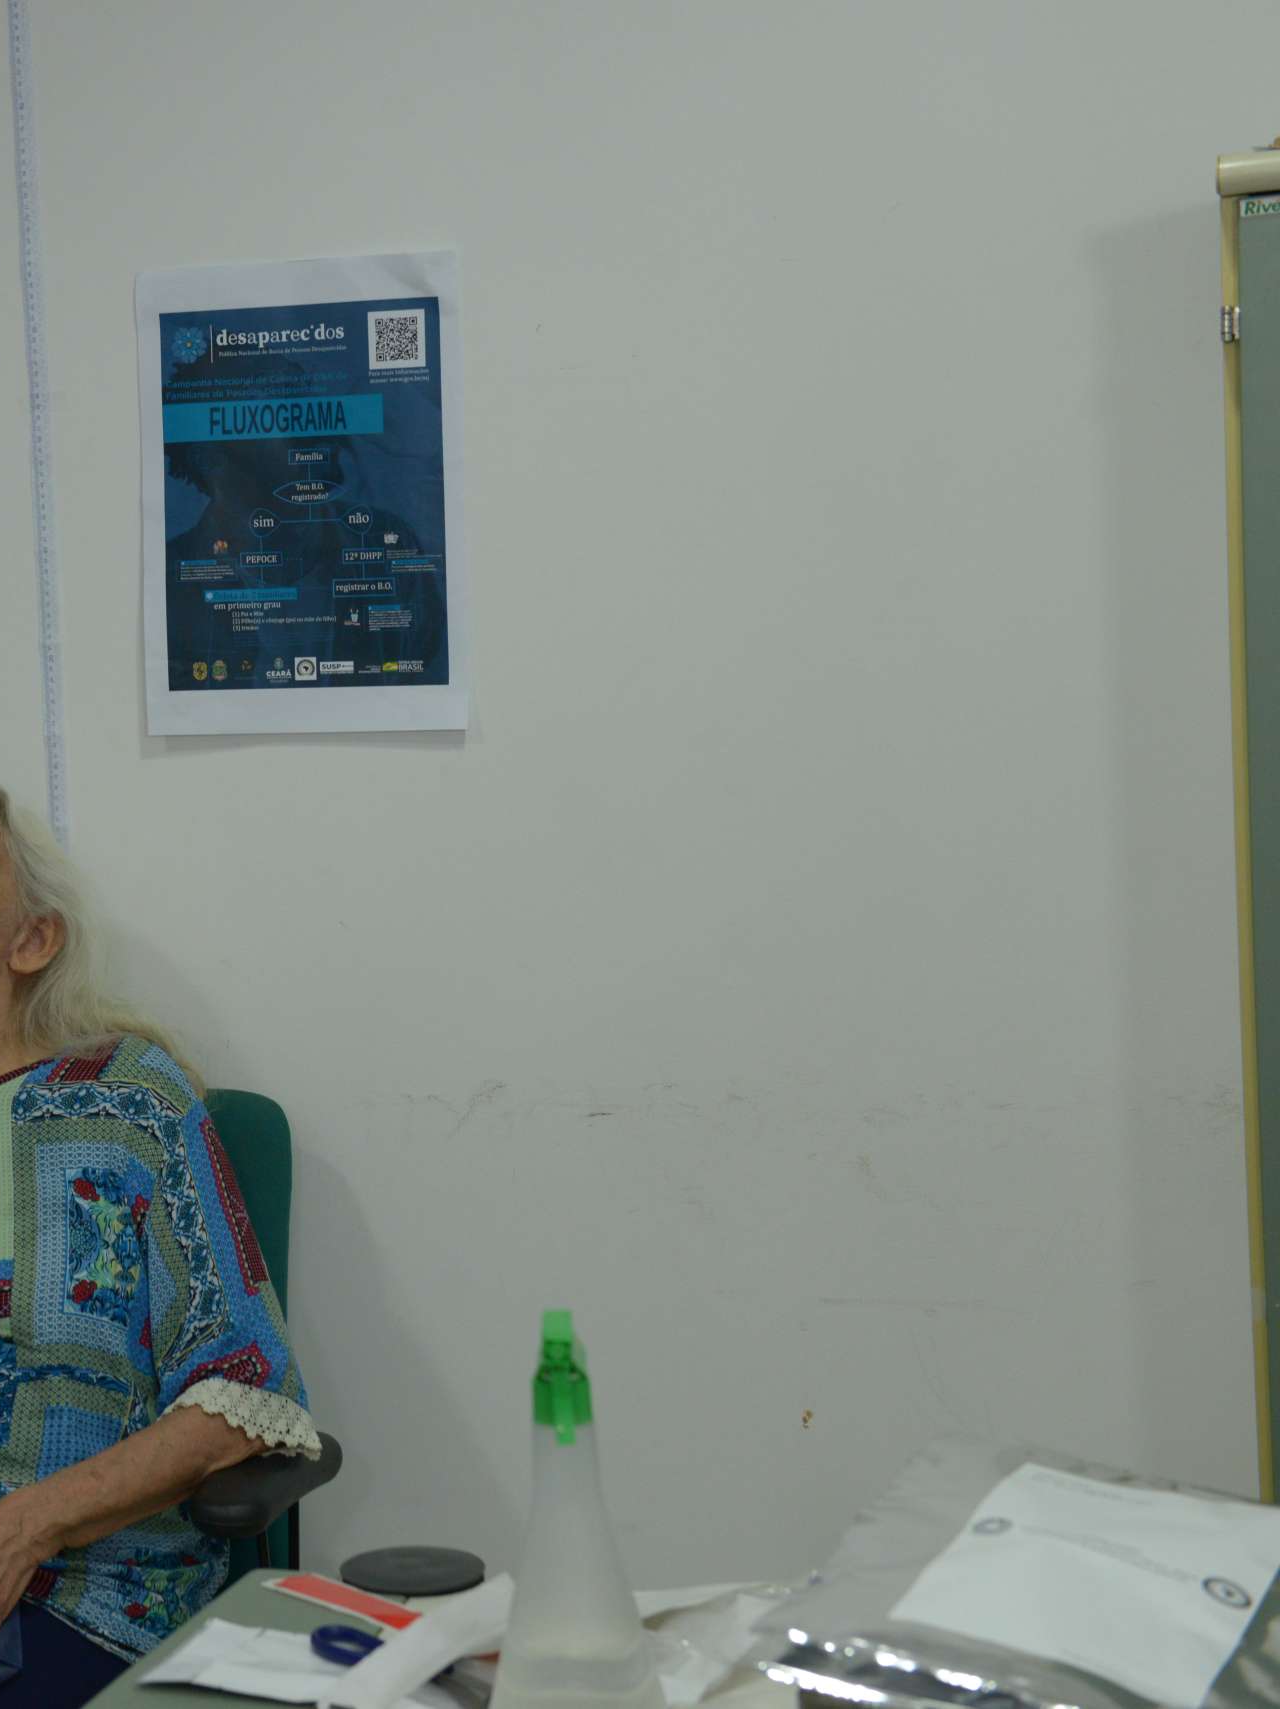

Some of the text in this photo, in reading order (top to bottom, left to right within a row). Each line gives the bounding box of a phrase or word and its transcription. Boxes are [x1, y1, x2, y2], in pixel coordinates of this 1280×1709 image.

[216, 324, 345, 349] desaparecdos
[209, 400, 347, 436] FLUXOGRAMA
[295, 452, 324, 462] Família
[296, 483, 310, 492] Tem
[291, 492, 329, 503] registrado?
[253, 515, 274, 528] sim
[348, 512, 370, 524] não
[246, 554, 278, 564] PEFOCE
[360, 552, 383, 560] DHPP
[336, 582, 370, 593] registrar
[377, 582, 393, 592] B.O.
[228, 602, 262, 612] primeiro
[264, 602, 281, 611] grau
[266, 668, 292, 678] CEARÁ
